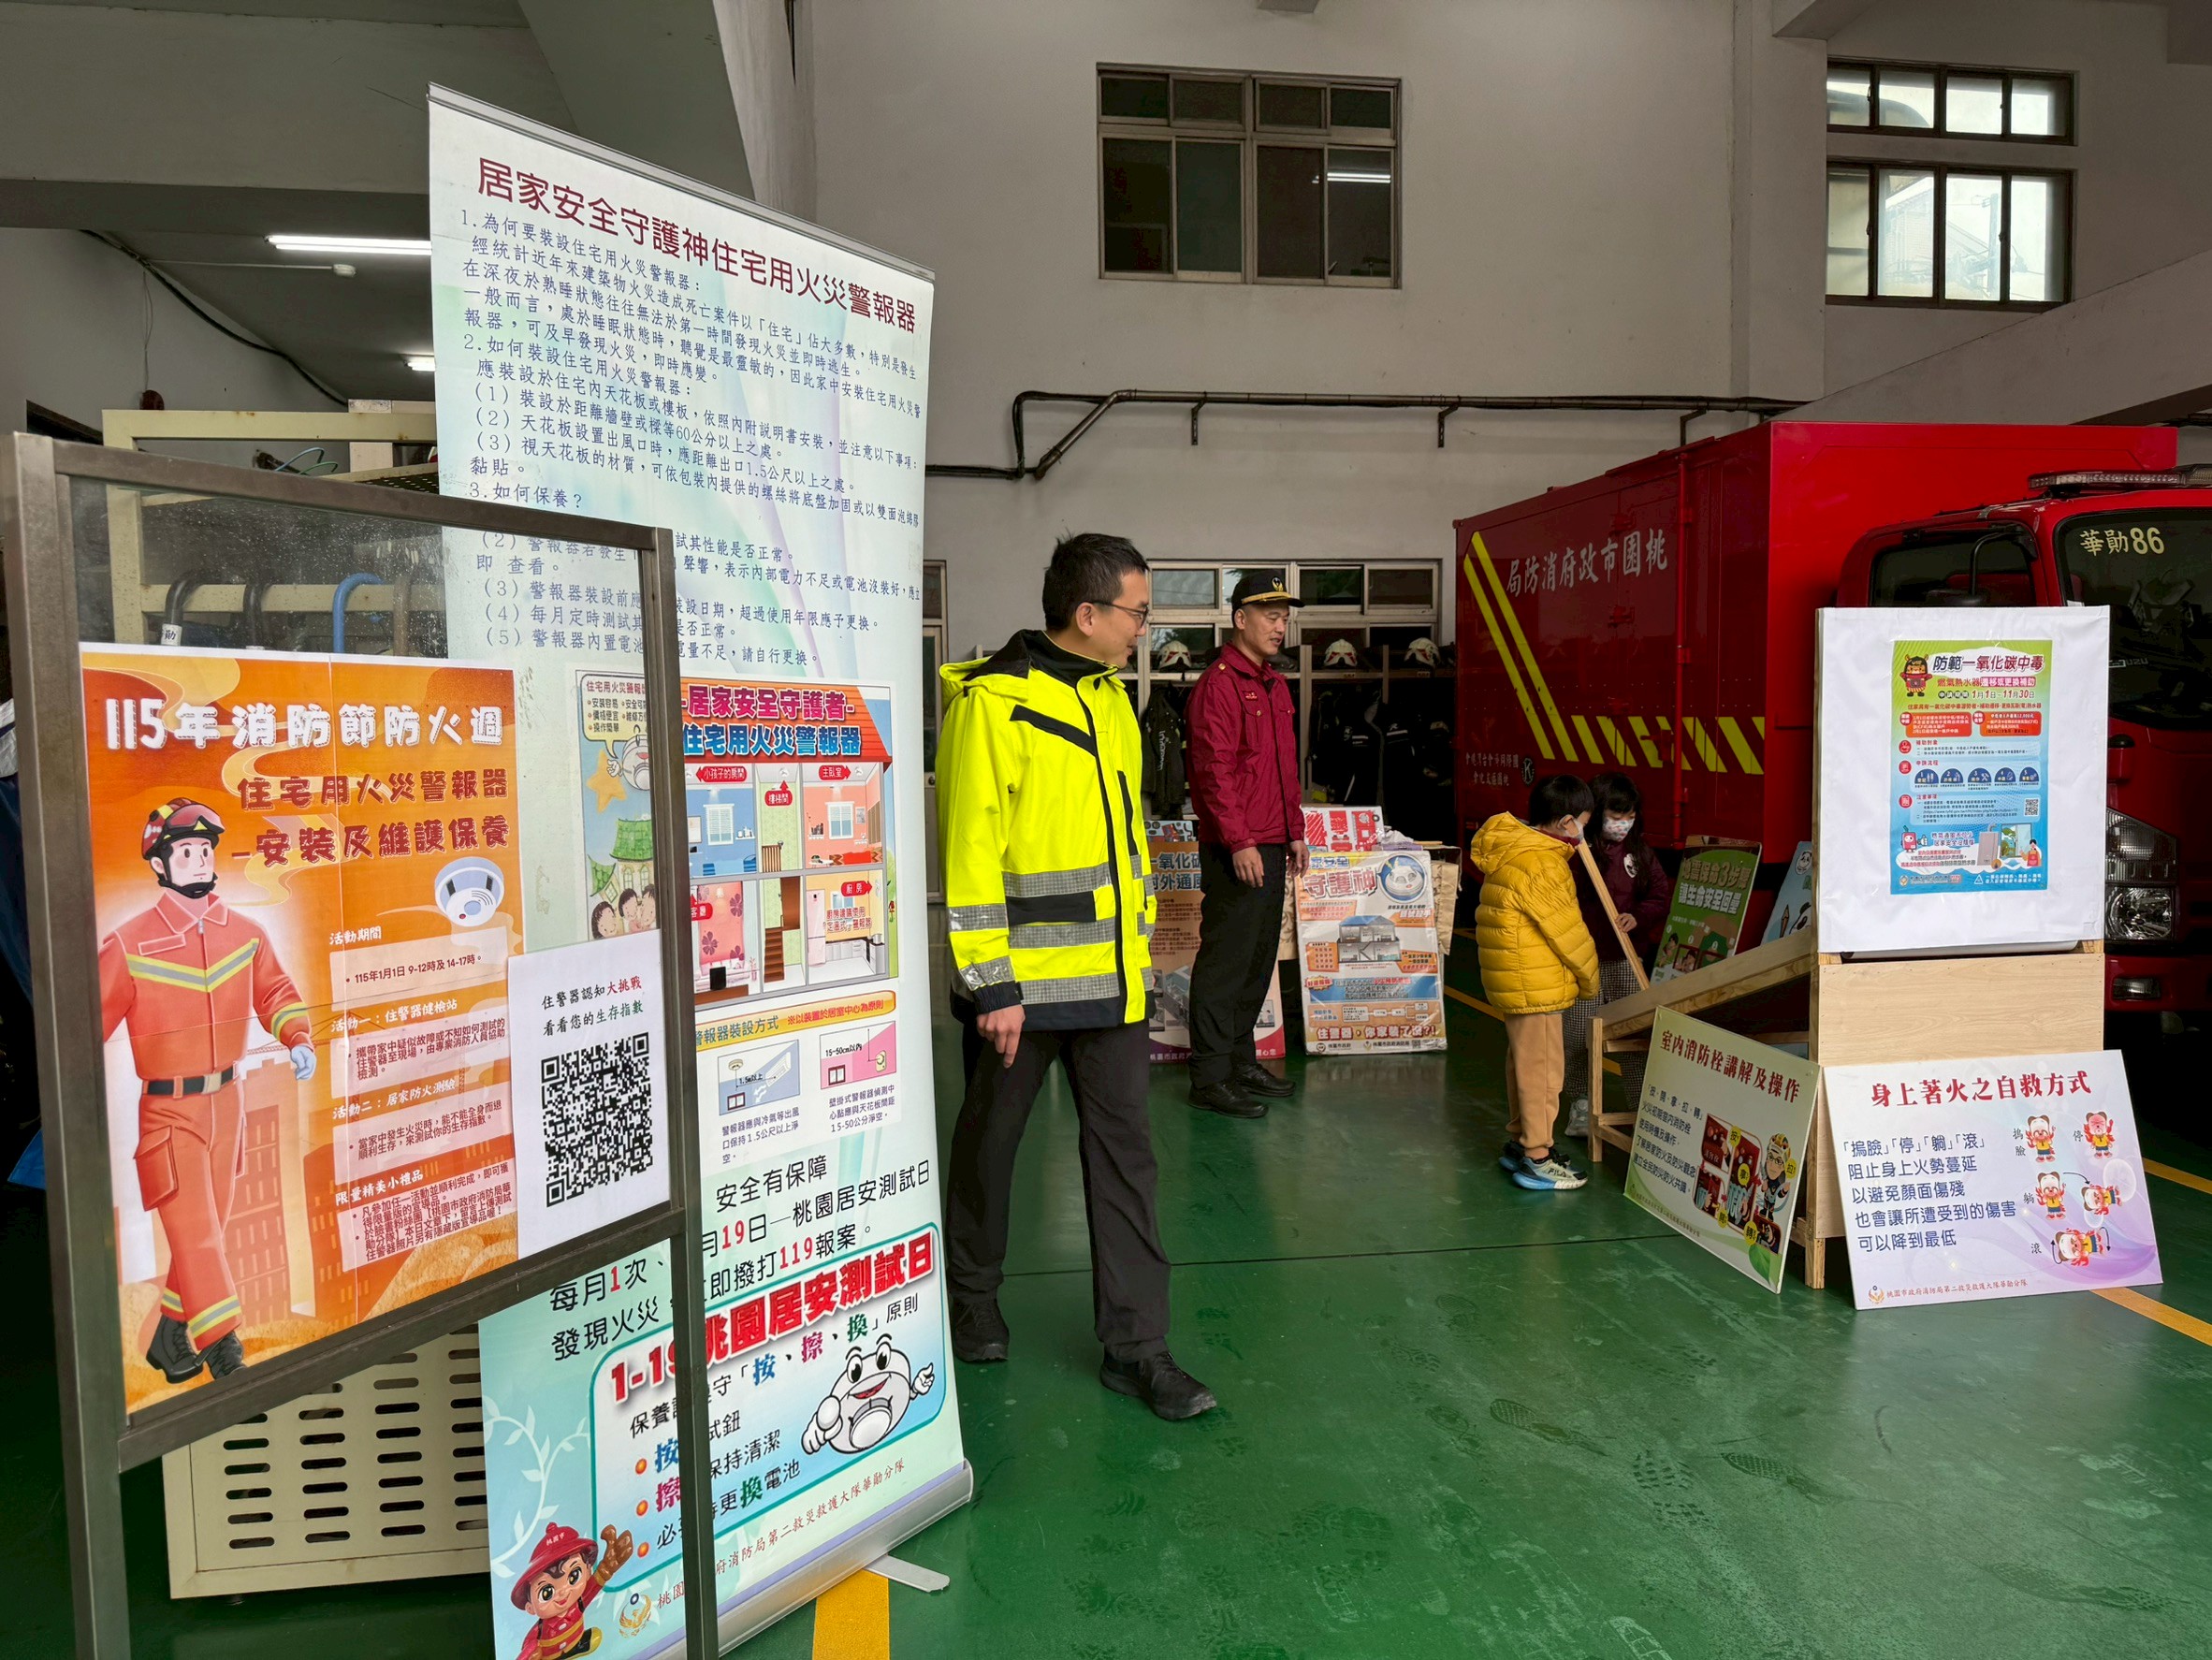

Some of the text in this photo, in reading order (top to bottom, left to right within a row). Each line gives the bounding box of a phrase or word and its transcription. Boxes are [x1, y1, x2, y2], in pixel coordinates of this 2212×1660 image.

[478, 157, 916, 333] 居家安全守護神住宅用火災警報器
[2080, 527, 2165, 557] 華勛86
[1932, 655, 2044, 672] 防範一氧化碳中毒
[105, 696, 504, 750] 115年消防節防火週
[683, 723, 862, 756] 住宅用火災警報器
[237, 768, 508, 811] 住宅用火災警報器
[329, 925, 382, 945] 活動期間
[541, 975, 643, 1010] 住警器認知大挑戰
[544, 999, 644, 1038] 看看您的生存指數
[1660, 1029, 1800, 1103] 室內消防栓講解及操作
[1871, 1070, 2092, 1108] 身上著火之自救方式
[716, 1155, 828, 1213] 安全有保障
[1848, 1155, 1978, 1180] 阻止身上火勢蔓延
[336, 1169, 424, 1207] 限量精美小禮品
[1852, 1180, 1966, 1205] 以避免顏面傷殘
[1855, 1201, 2016, 1230] 也會讓所遭受到的傷害
[1858, 1229, 1957, 1252] 可以降到最低
